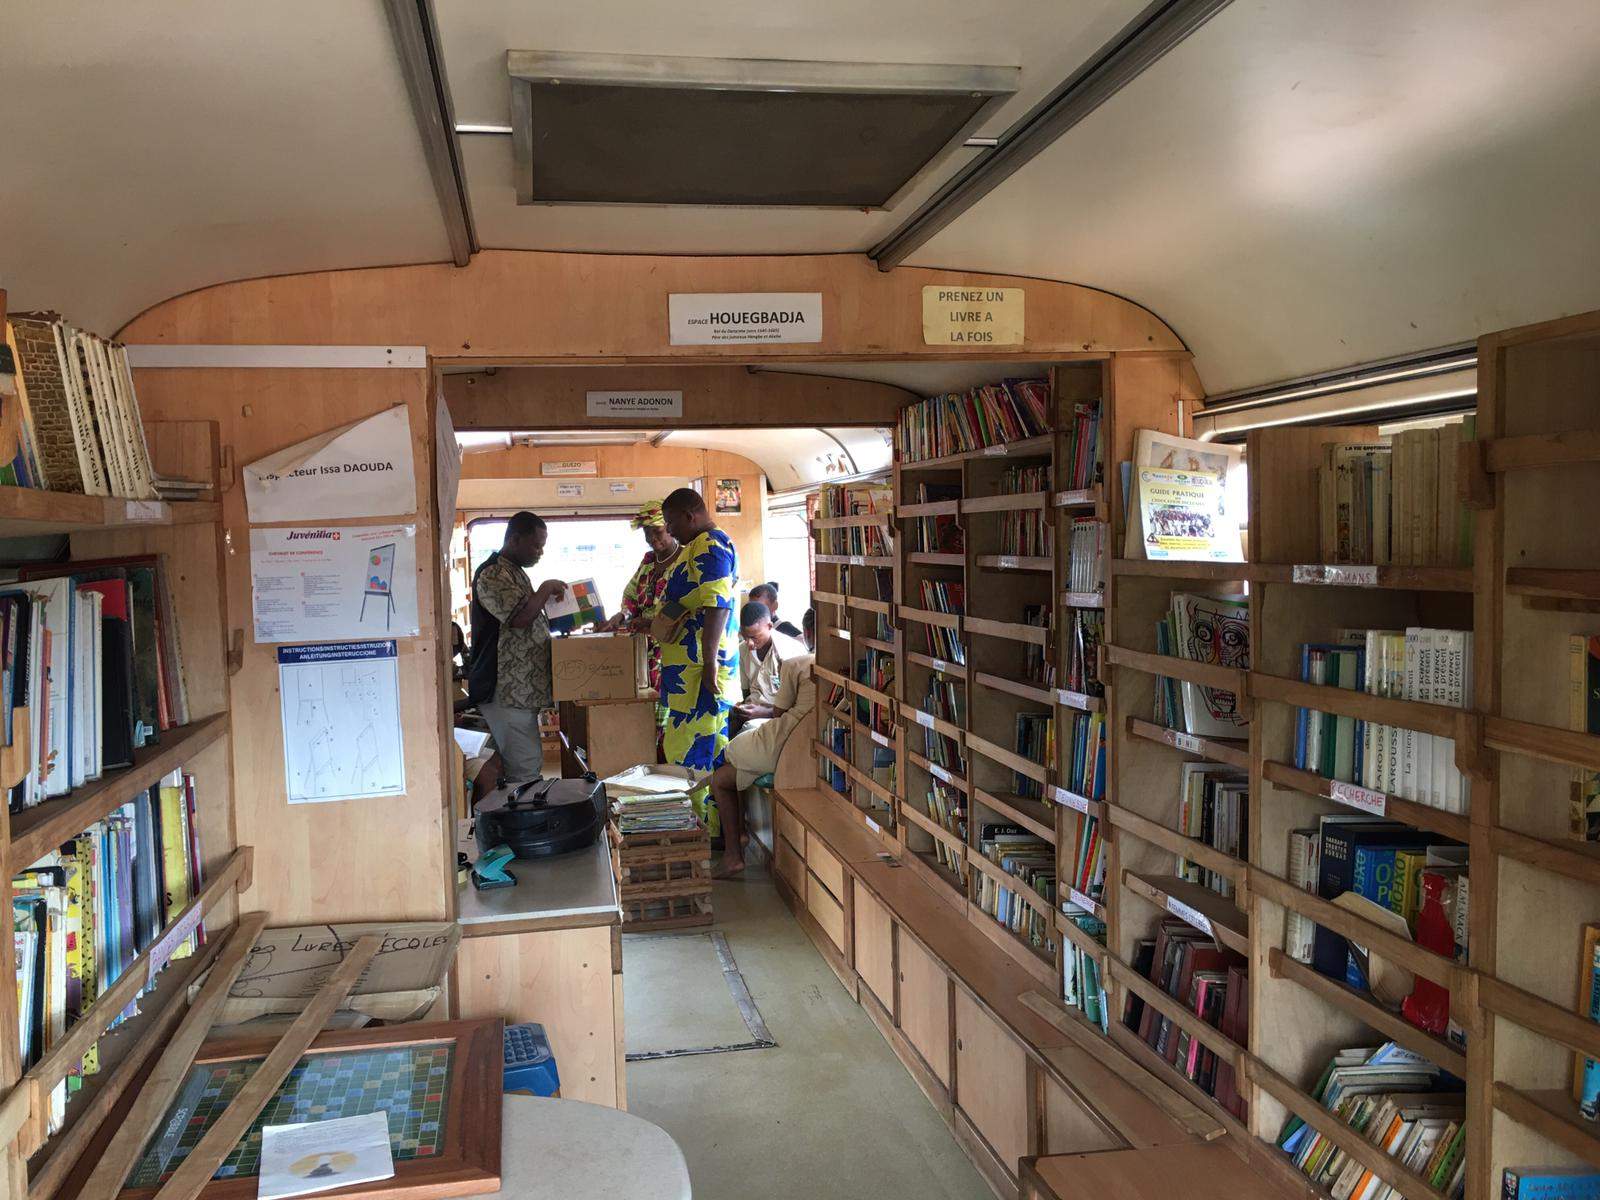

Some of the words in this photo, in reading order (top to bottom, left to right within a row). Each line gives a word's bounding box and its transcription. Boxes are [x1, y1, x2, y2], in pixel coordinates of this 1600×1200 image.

[939, 291, 983, 302] PRENEZ
[986, 291, 1004, 302] UN
[710, 311, 805, 325] HOUEGBADJA
[950, 311, 981, 322] LIVRE
[984, 312, 993, 322] A
[950, 331, 964, 342] LA
[967, 331, 993, 342] FOIS
[608, 398, 635, 406] NANYE
[637, 398, 673, 406] ADONON
[320, 464, 341, 475] Issa
[343, 461, 394, 473] DAOUDA
[1150, 488, 1170, 496] GUIDE
[1172, 490, 1205, 498] PRATIQUE
[287, 530, 332, 541] Juvénilia
[1405, 762, 1412, 774] La
